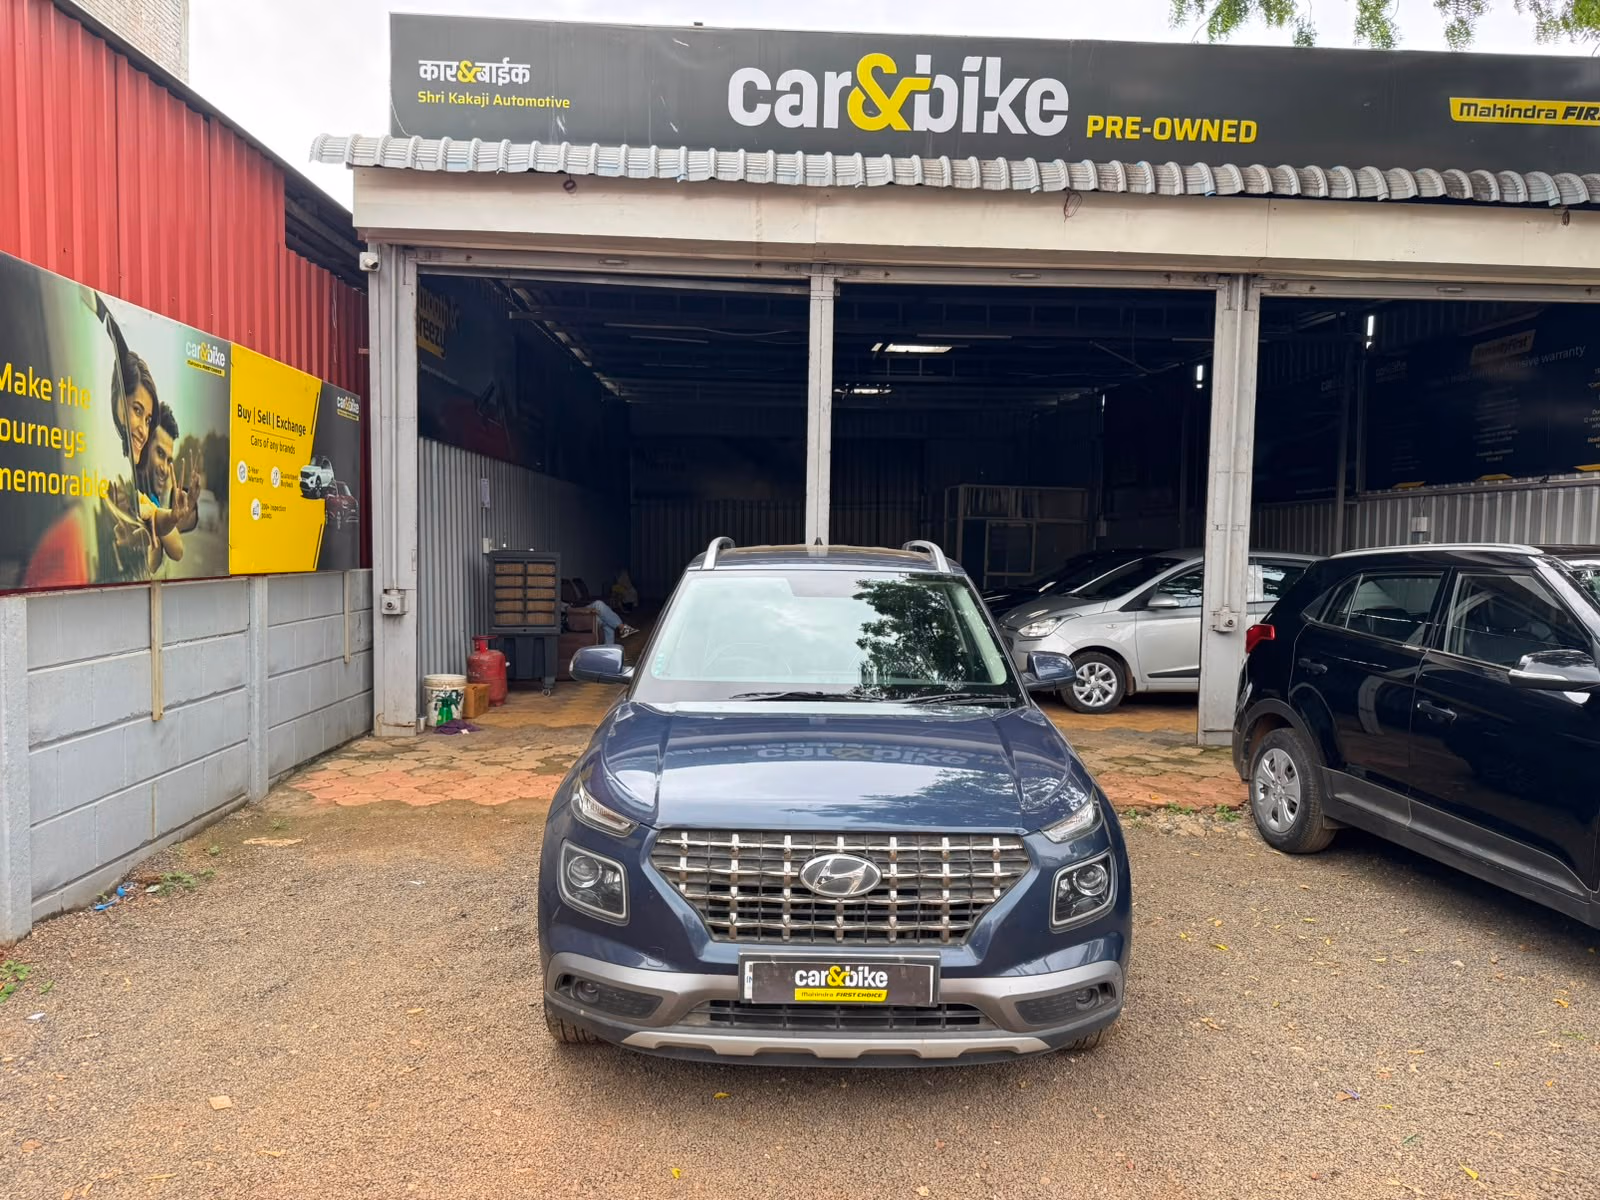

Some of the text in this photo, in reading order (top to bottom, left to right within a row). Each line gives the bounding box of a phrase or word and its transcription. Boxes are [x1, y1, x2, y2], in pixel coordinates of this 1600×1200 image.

[418, 57, 531, 86] कार&बाईक
[418, 90, 571, 109] Shri Kakaji Automotive
[728, 52, 1069, 136] car&bike
[1459, 102, 1600, 120] Mahindra FIR
[1086, 114, 1258, 144] PRE-OWNED
[186, 342, 225, 367] car&bike
[58, 376, 91, 409] the
[237, 403, 252, 423] Buy
[257, 409, 271, 426] Sell
[276, 415, 307, 437] Exchange
[0, 417, 87, 458] ourneys
[250, 435, 296, 455] Cars of any brands
[794, 965, 889, 988] car&bike
